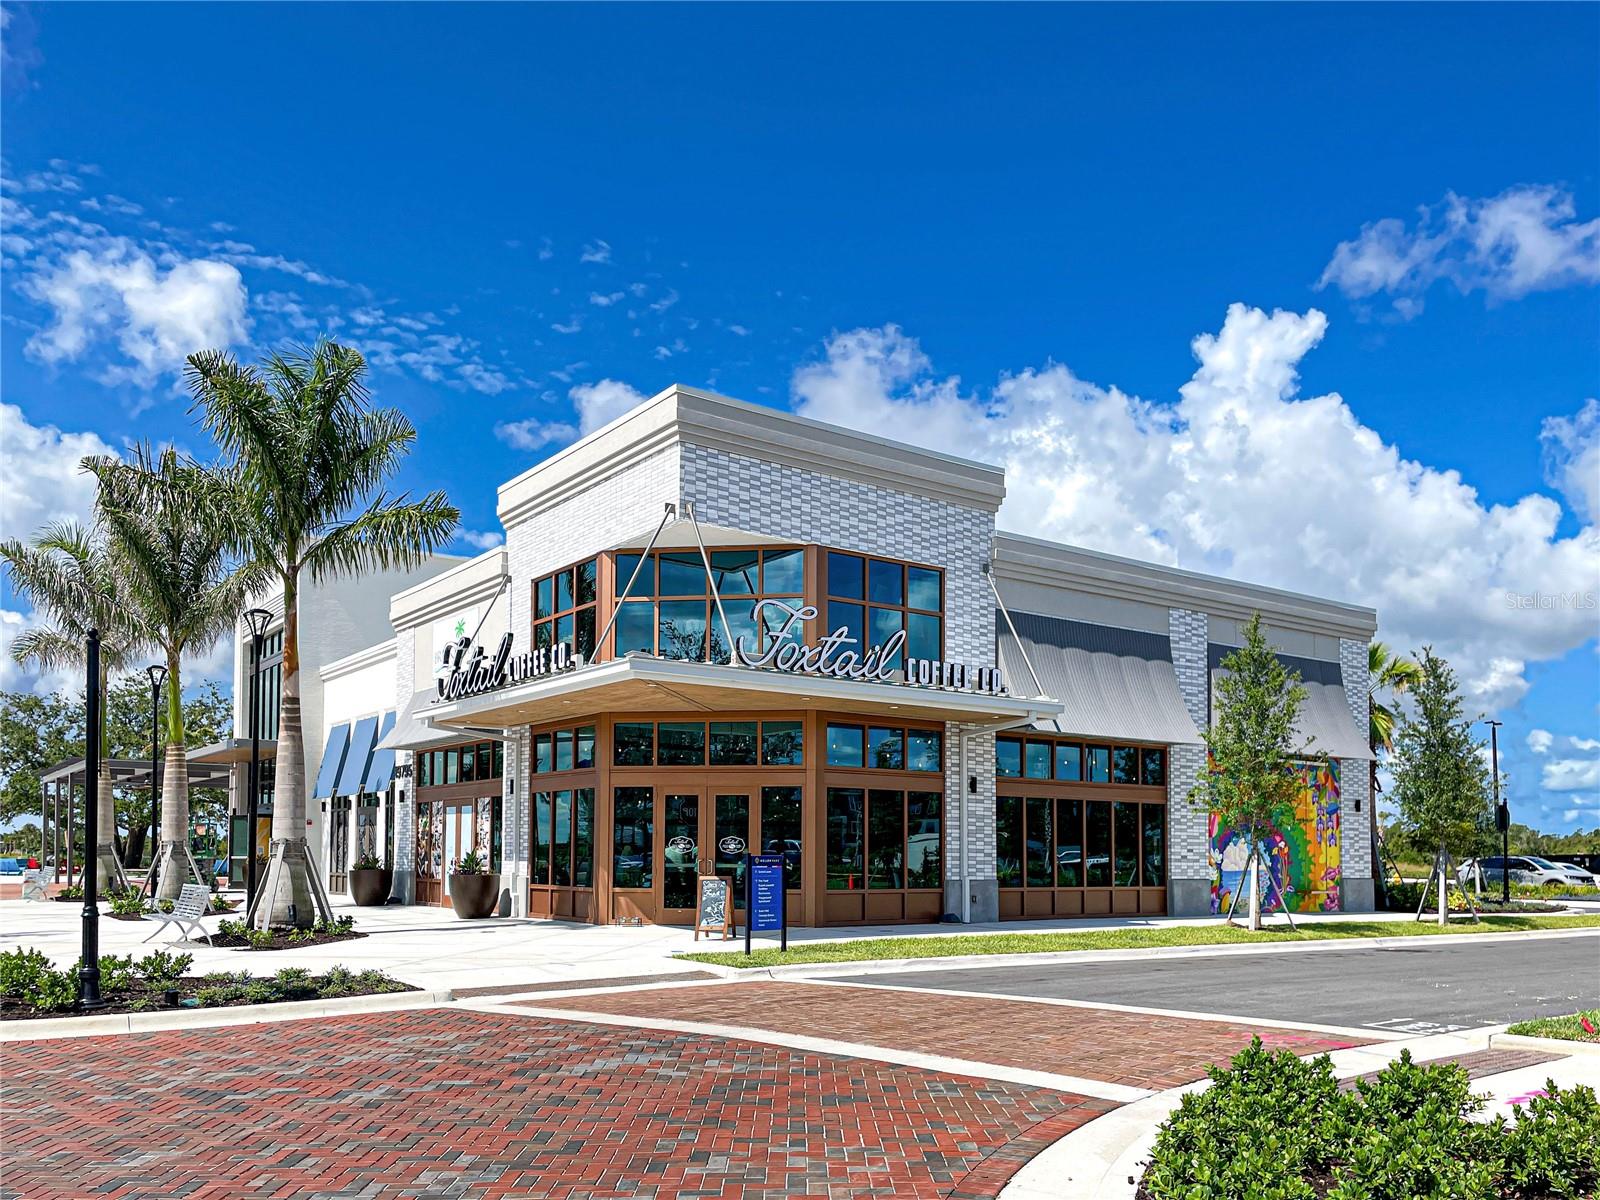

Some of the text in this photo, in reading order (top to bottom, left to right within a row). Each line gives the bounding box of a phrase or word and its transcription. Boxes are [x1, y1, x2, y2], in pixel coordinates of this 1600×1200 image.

[437, 631, 514, 700] Foxtail
[505, 647, 546, 682] COFFEE
[551, 641, 571, 673] CO.
[736, 599, 1009, 694] Foxtail COFFEE CO.
